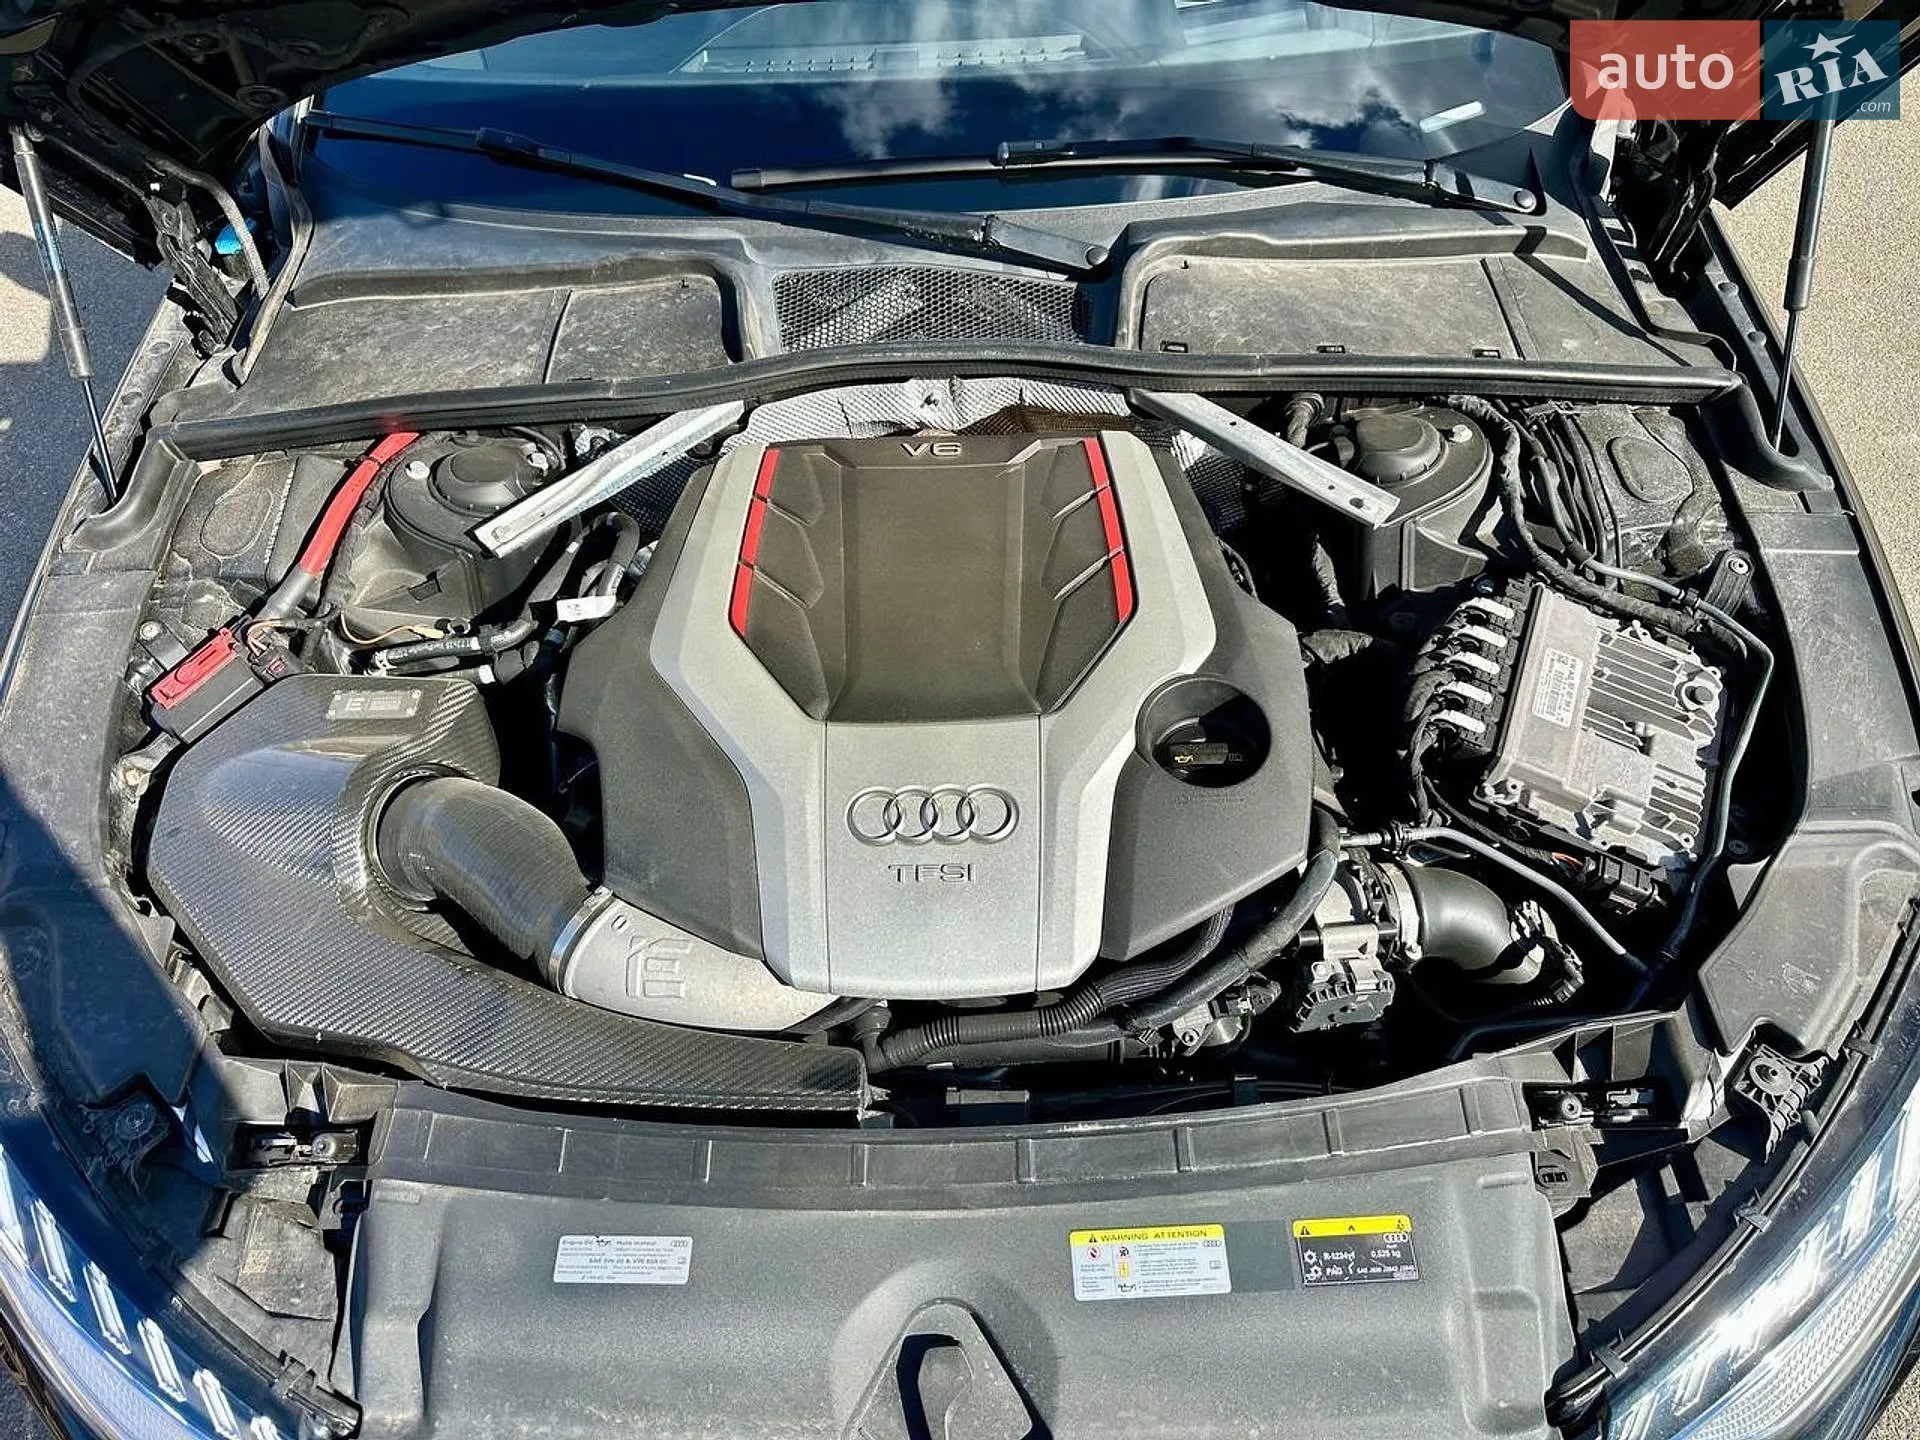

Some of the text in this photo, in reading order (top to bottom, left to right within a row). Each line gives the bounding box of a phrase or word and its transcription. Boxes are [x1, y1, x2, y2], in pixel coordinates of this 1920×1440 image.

[900, 442, 962, 457] V6
[888, 863, 976, 882] TFSI
[1100, 1229, 1208, 1242] WARNING ATTENTION
